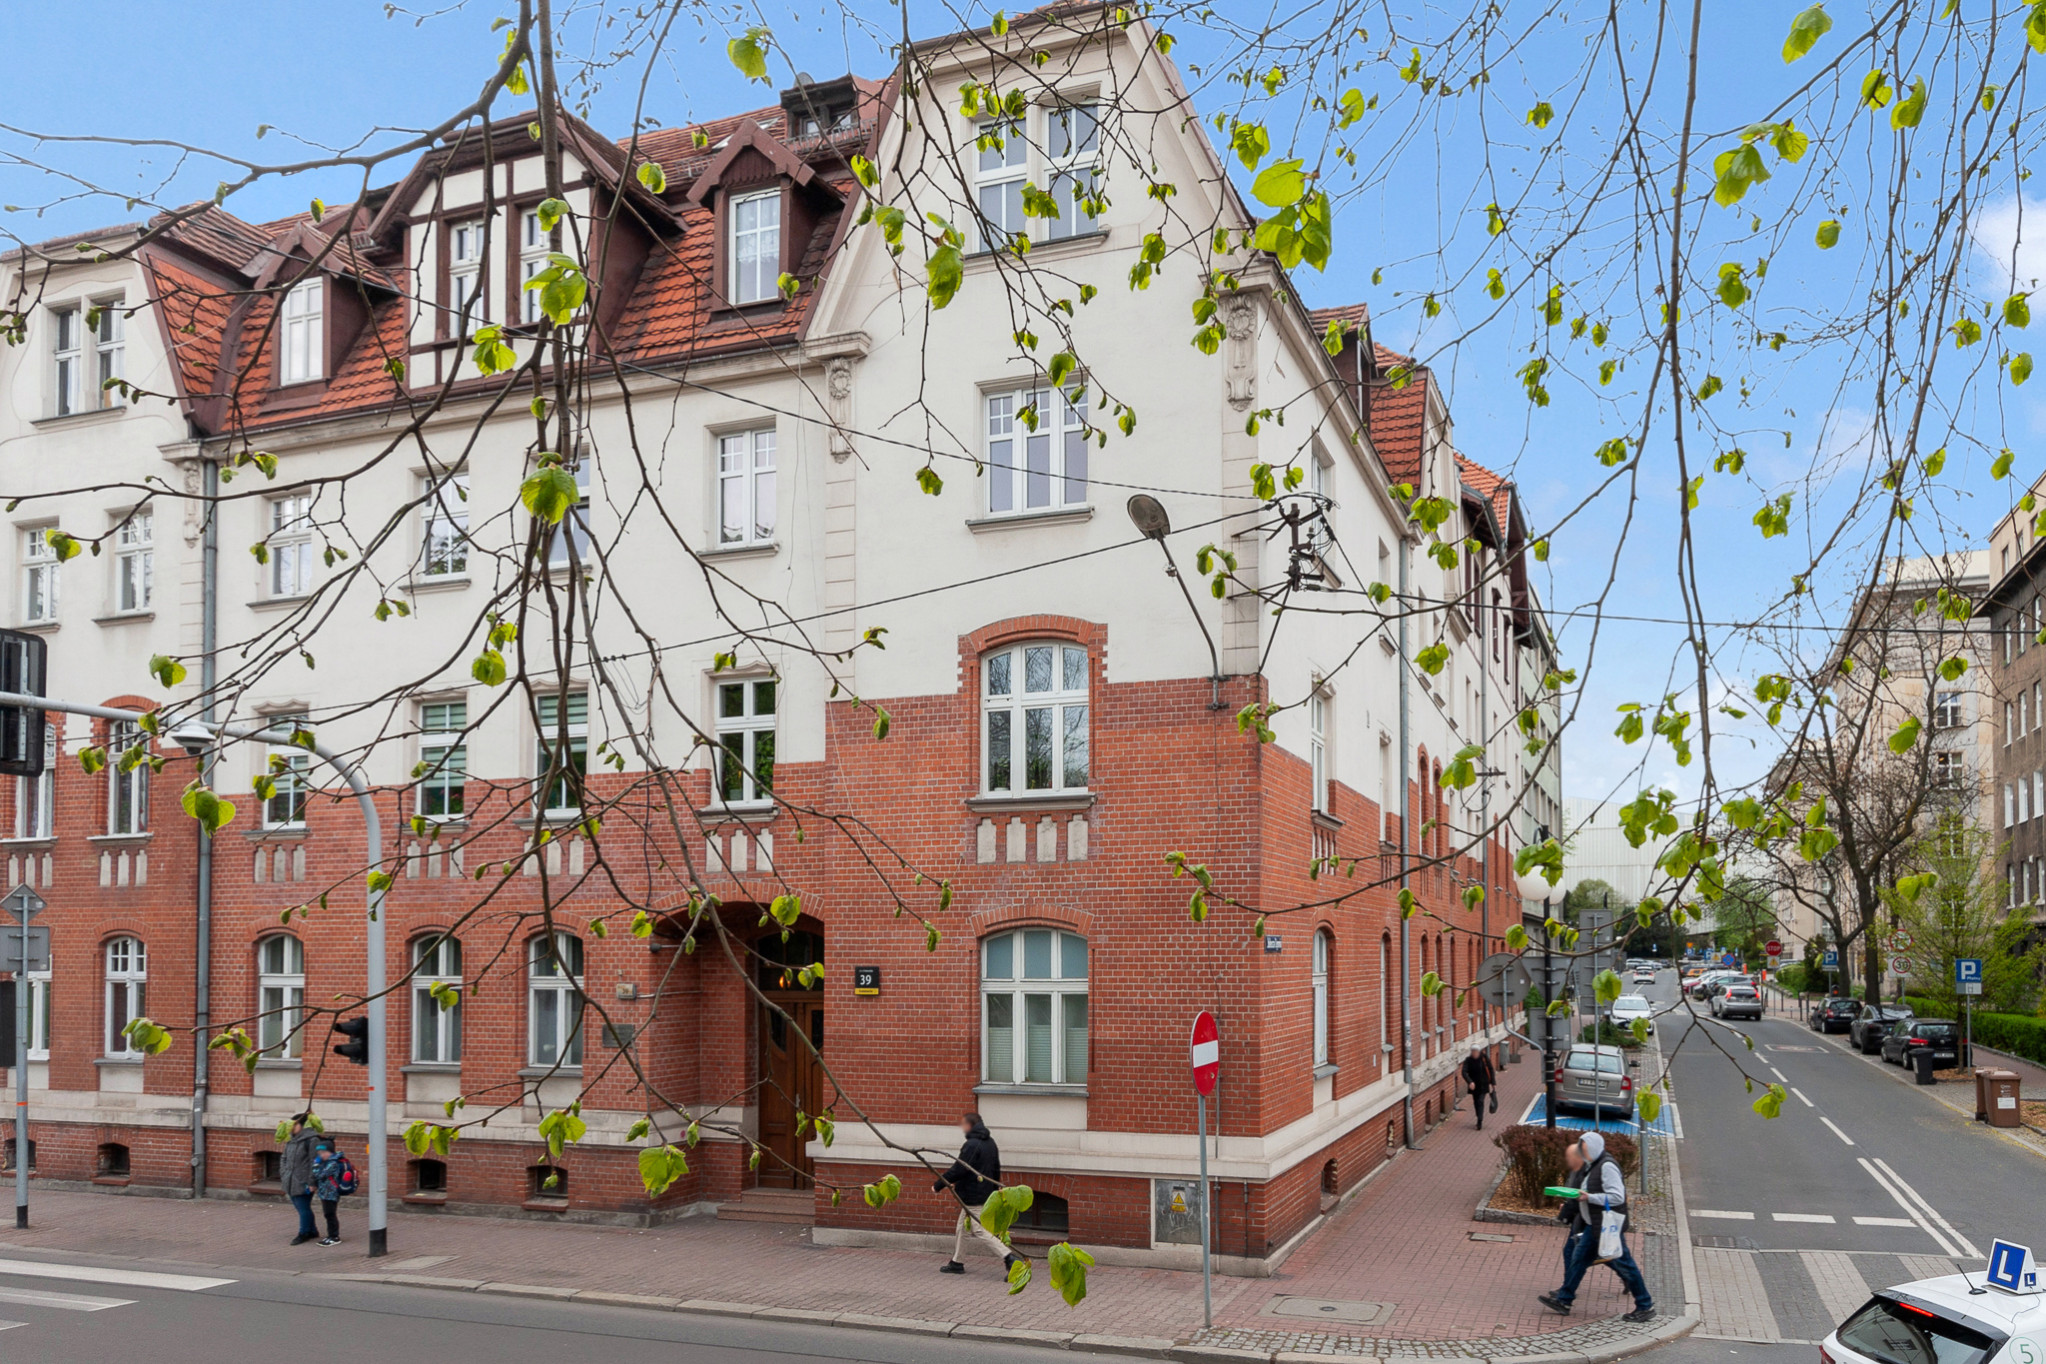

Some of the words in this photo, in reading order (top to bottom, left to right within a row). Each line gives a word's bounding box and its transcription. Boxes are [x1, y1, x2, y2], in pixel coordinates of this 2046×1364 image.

[1825, 952, 1835, 964] P
[1895, 960, 1909, 969] 30
[1961, 961, 1976, 980] P
[860, 974, 872, 985] 39
[1997, 1250, 2013, 1282] L
[2027, 1274, 2034, 1285] L
[2020, 1343, 2034, 1364] 5
